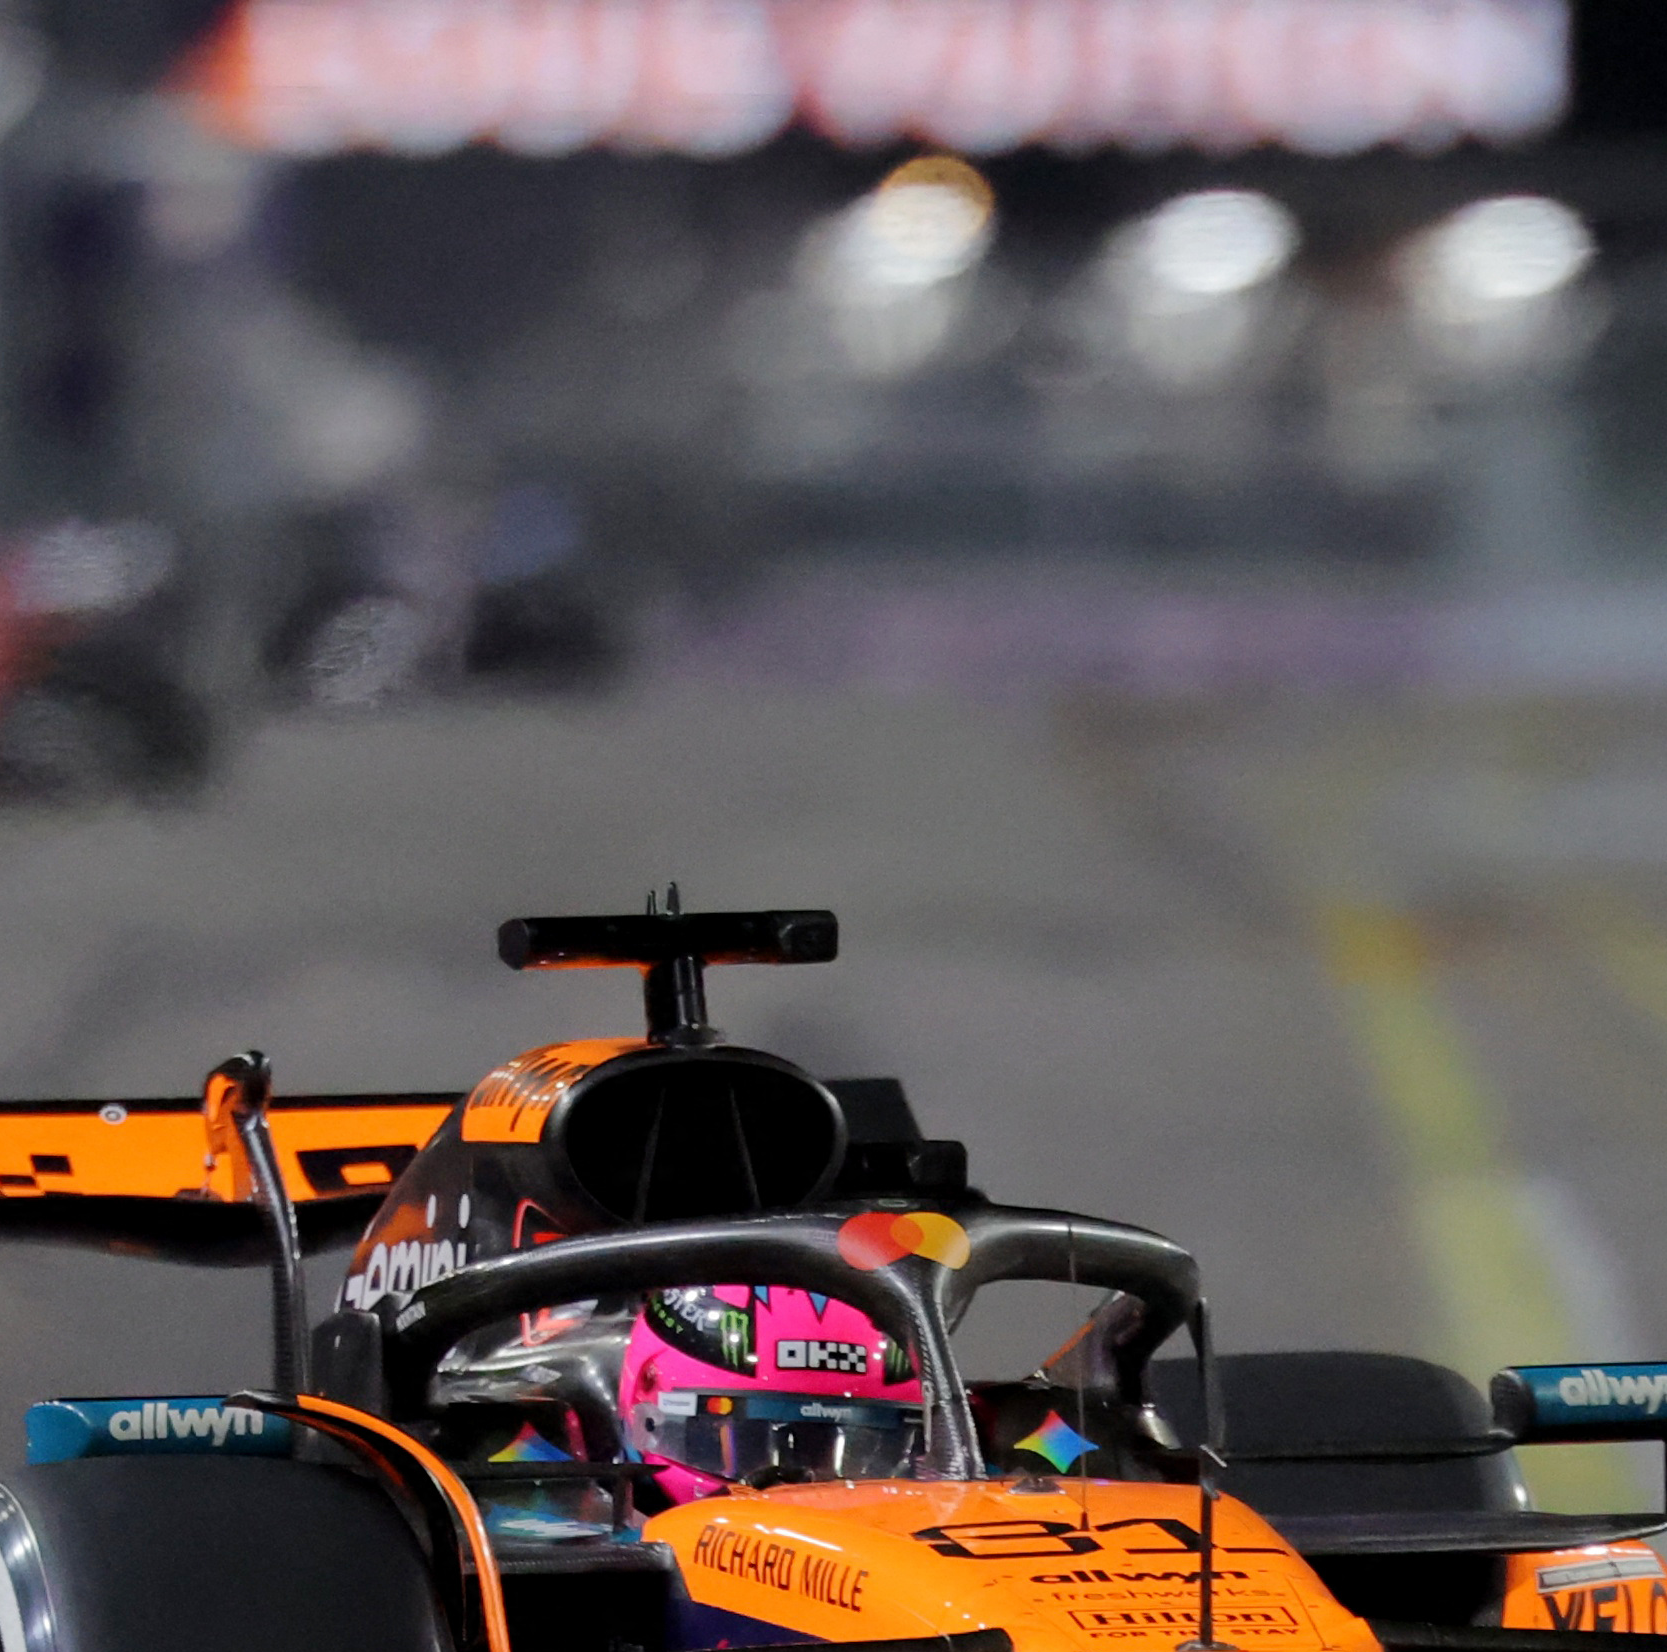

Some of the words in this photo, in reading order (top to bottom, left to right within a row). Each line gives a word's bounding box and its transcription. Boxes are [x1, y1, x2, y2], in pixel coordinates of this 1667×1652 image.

[775, 1338, 868, 1375] OKX
[108, 1402, 264, 1447] allwyn
[910, 1518, 1291, 1560] 81
[693, 1525, 796, 1591] RICHARD
[799, 1553, 870, 1613] MILLE
[1090, 1610, 1276, 1626] Hilton
[1162, 1629, 1219, 1638] TH
